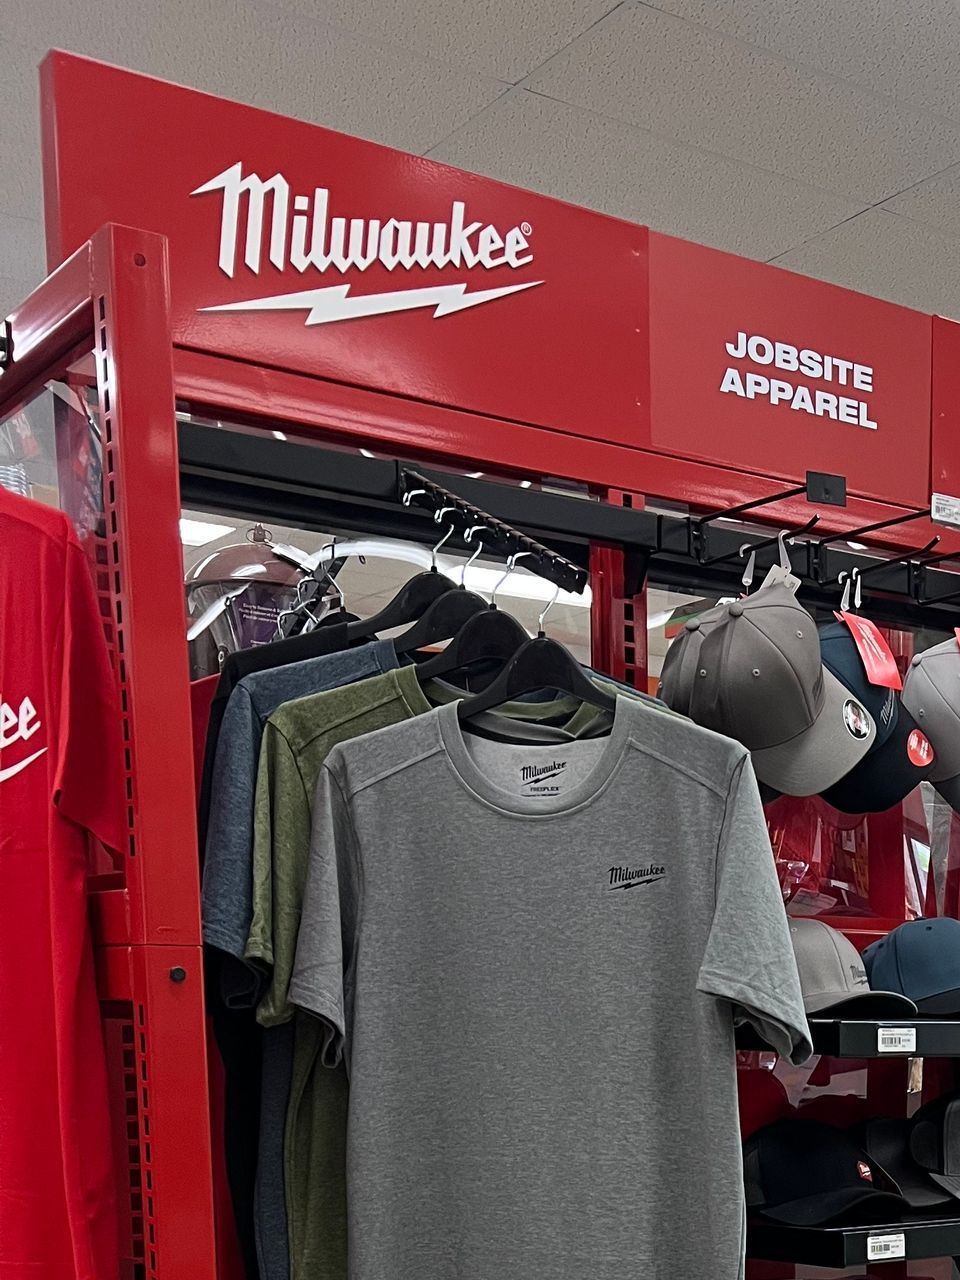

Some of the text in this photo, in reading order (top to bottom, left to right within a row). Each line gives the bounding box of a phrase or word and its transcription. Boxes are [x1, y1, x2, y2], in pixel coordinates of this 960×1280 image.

[725, 331, 873, 392] JOBSITE
[719, 367, 878, 430] APPAREL
[520, 761, 567, 781] Milwaukee
[608, 864, 665, 885] Milwaukee
